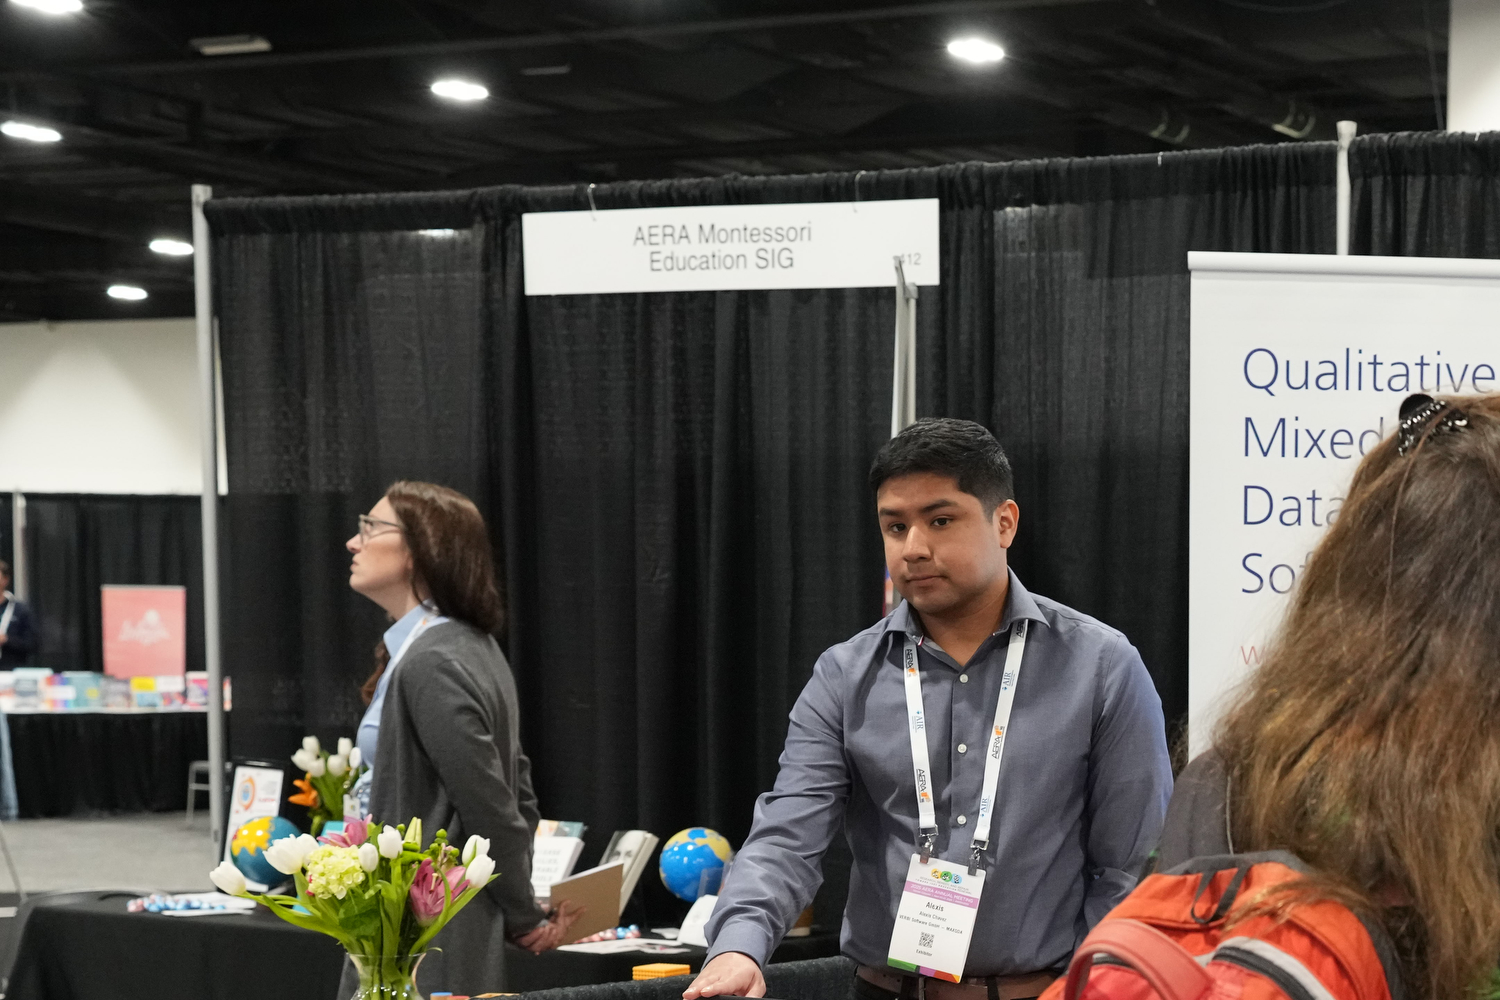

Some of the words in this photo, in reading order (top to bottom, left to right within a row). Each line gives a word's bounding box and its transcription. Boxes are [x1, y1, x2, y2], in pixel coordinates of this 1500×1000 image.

[633, 224, 691, 247] AERA
[698, 221, 812, 245] Montessori
[649, 250, 748, 272] Education
[754, 248, 794, 270] SIG
[1242, 347, 1496, 396] Qualitative
[1243, 416, 1384, 460] Mixed
[925, 901, 944, 912] Alexis
